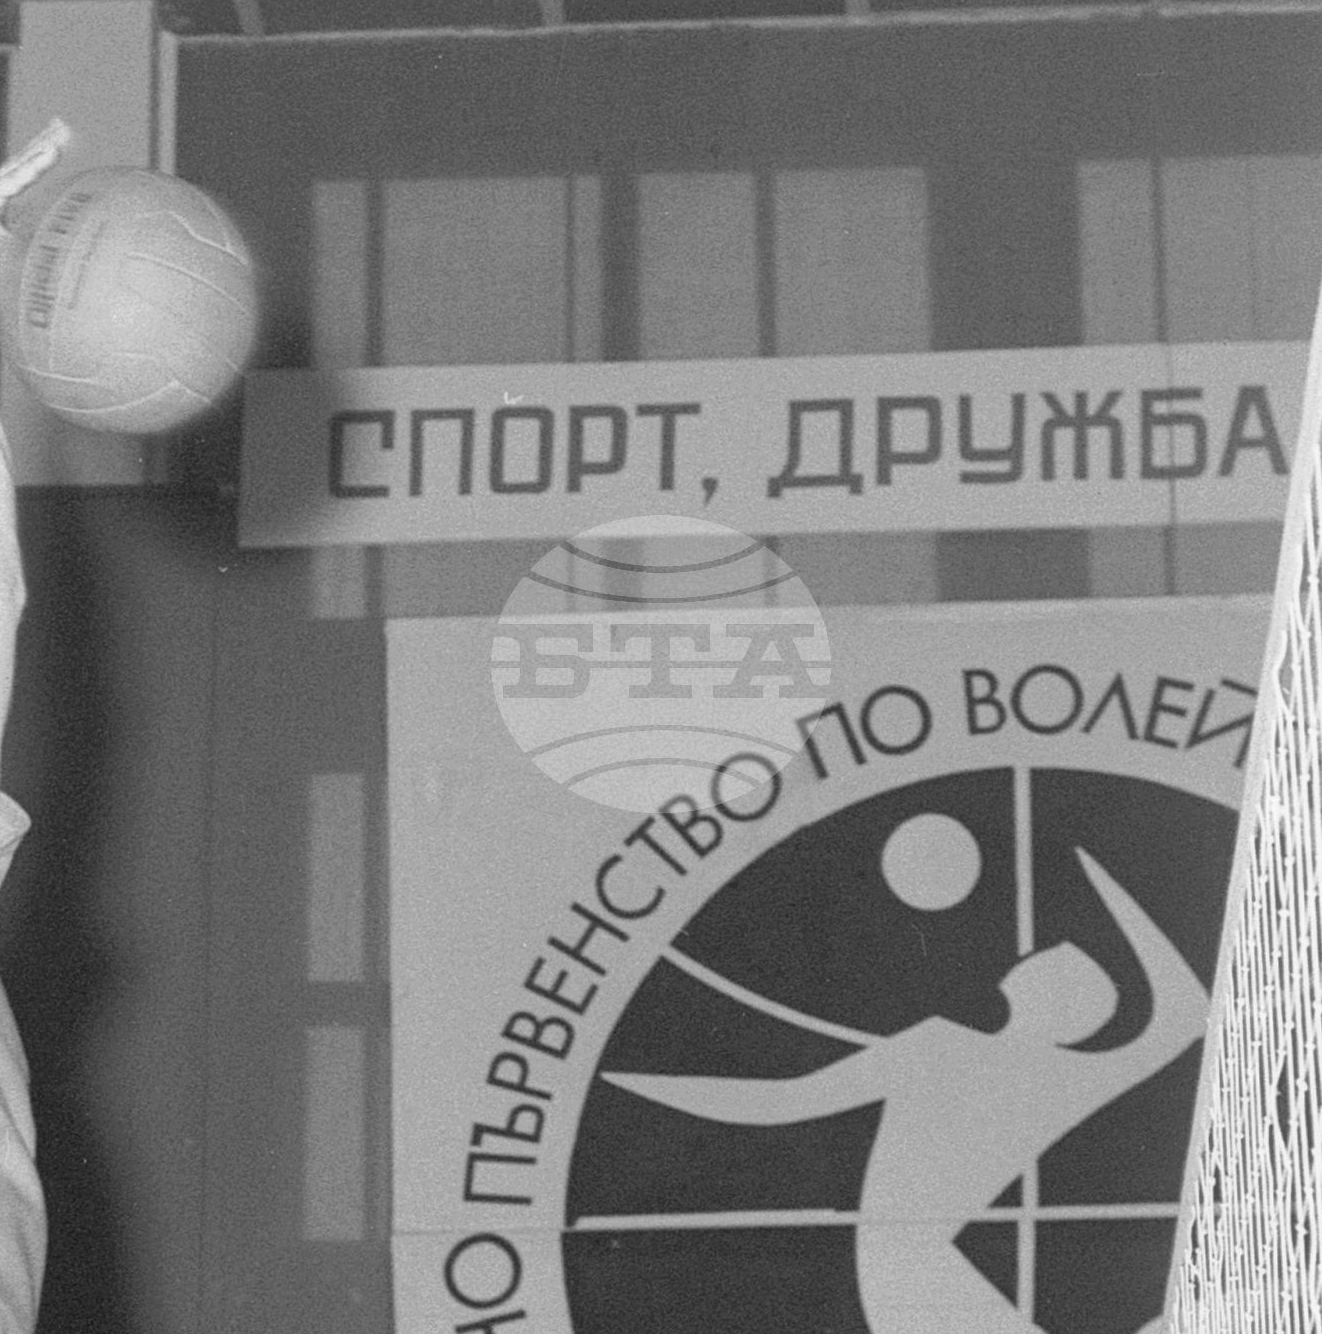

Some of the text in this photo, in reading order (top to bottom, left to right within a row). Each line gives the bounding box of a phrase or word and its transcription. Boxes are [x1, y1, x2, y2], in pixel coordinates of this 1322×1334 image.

[327, 401, 719, 507] СПОРТ,
[767, 384, 1291, 498] ДРУЖБА
[461, 752, 783, 1207] ПЪРВЕНСТВО
[796, 684, 933, 781] ПО
[962, 663, 1259, 769] ВОЛЕЙ
